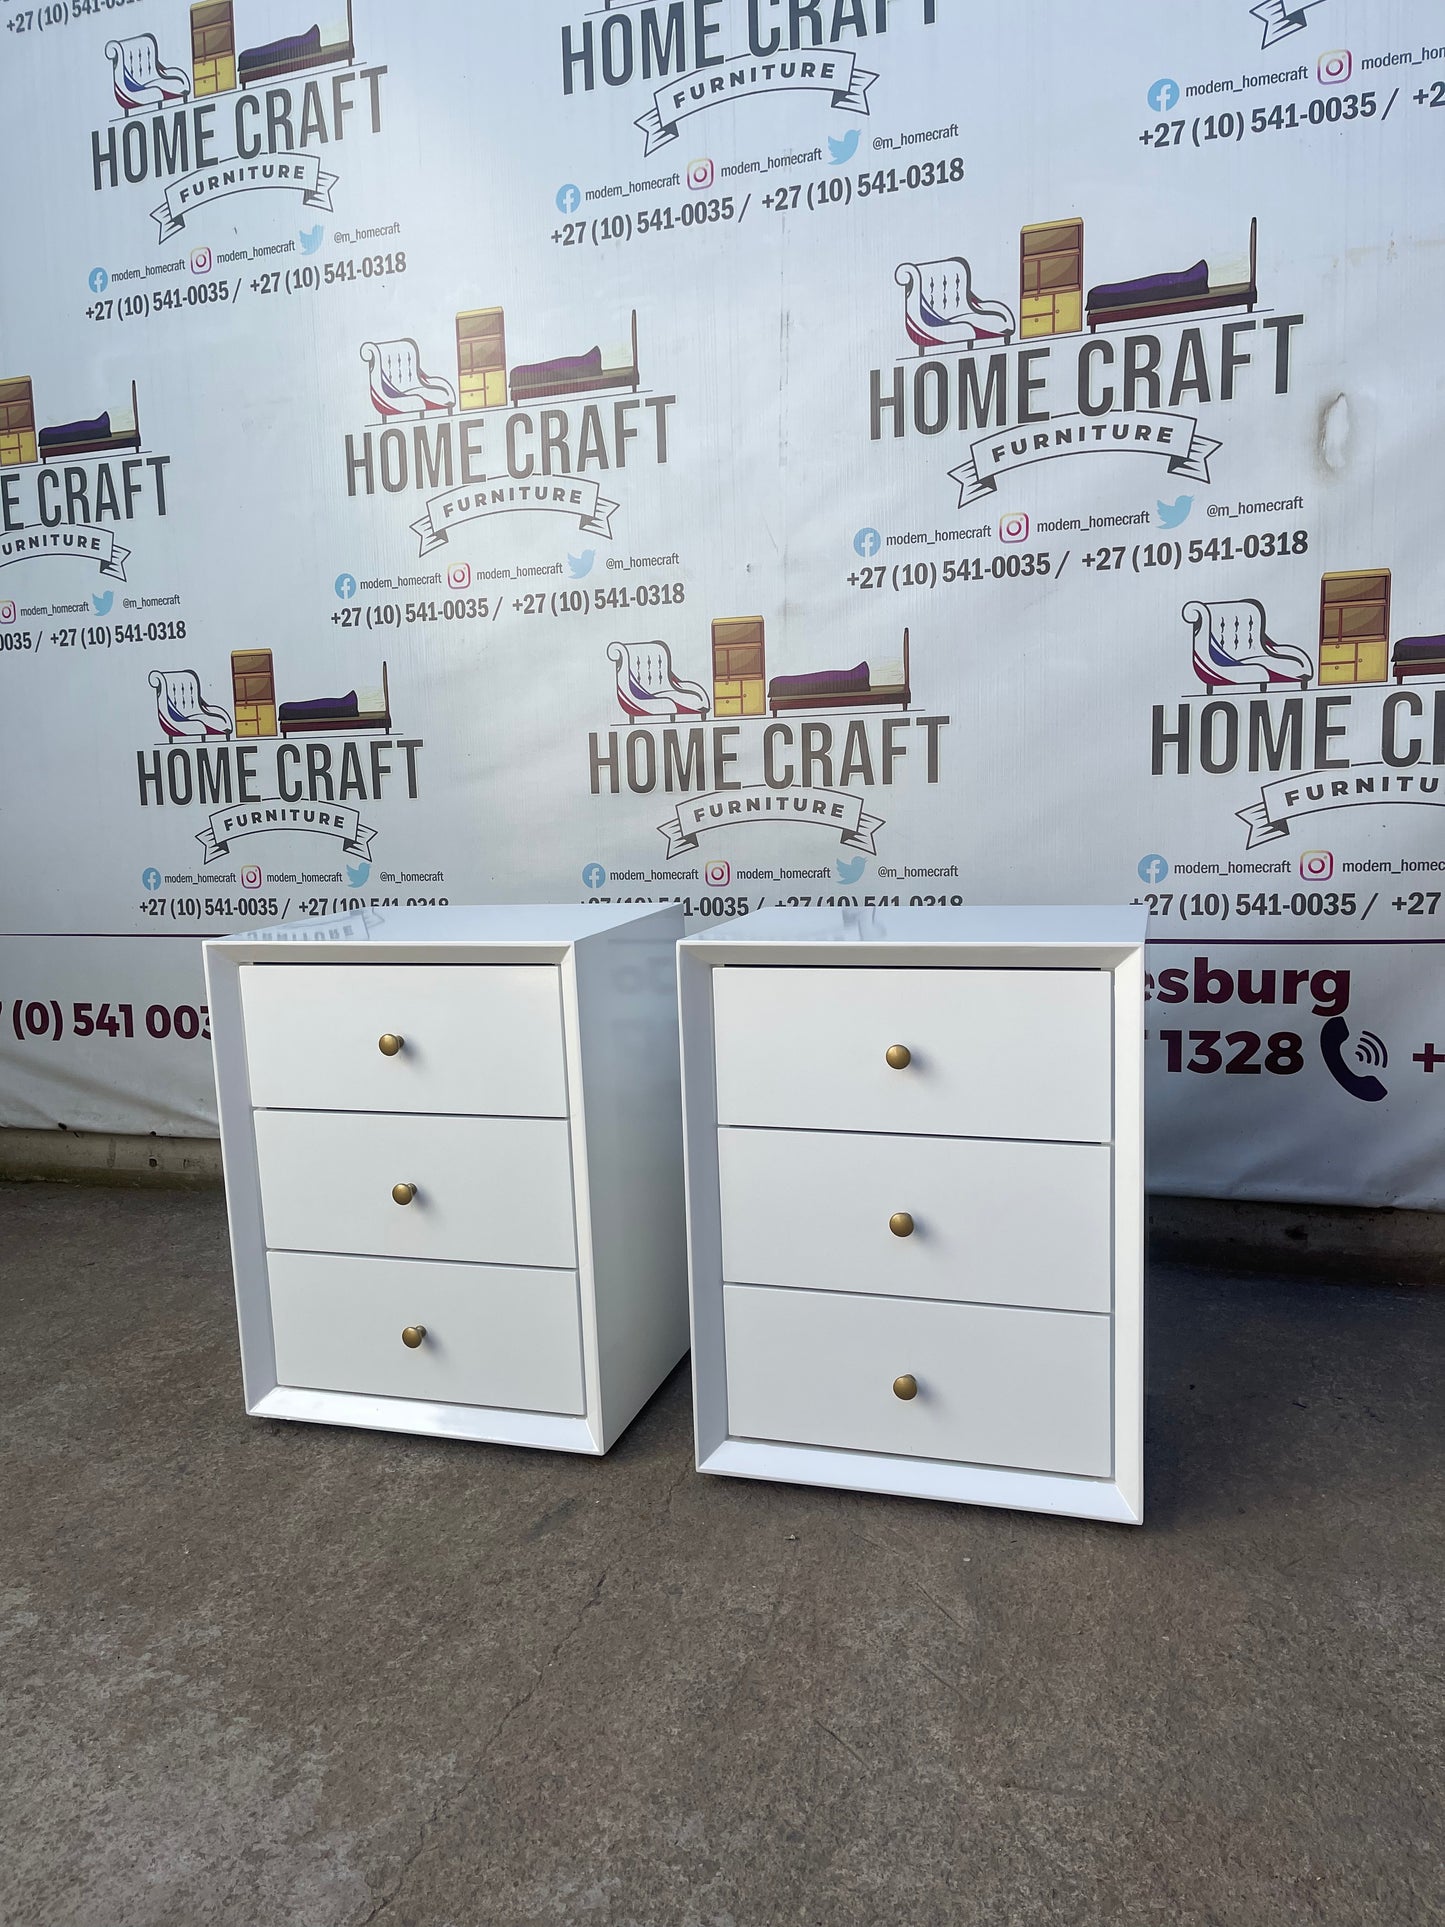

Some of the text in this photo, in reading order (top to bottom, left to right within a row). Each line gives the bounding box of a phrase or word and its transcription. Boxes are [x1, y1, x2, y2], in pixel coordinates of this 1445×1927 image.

[7, 11, 33, 33] +27
[38, 2, 68, 31] (10)
[562, 0, 725, 95] HOME
[674, 62, 836, 109] FURNITURE
[91, 65, 388, 191] HOME CRAFT
[872, 124, 958, 150] @m_homecraft
[1139, 119, 1186, 148] +27
[1192, 111, 1245, 147] (10)
[1251, 92, 1377, 134] 541-0035
[179, 164, 306, 203] FURNITURE
[551, 222, 587, 247] +27
[591, 214, 633, 246] (10)
[637, 196, 734, 234] 541-0035
[762, 186, 802, 212] +27
[807, 177, 852, 210] (10)
[857, 157, 965, 198] 541-0318
[334, 222, 401, 245] @m_homecraft
[85, 301, 113, 322] +27
[118, 294, 150, 320] (10)
[152, 281, 230, 312] 541-0035
[250, 271, 281, 296] +27
[285, 265, 320, 295] (10)
[324, 252, 407, 285] 541-0318
[869, 314, 1304, 440] HOME CRAFT
[344, 395, 676, 496] HOME CRAFT
[991, 425, 1174, 463] FURNITURE
[37, 456, 171, 528] CRAFT
[442, 486, 583, 518] FURNITURE
[1206, 495, 1304, 518] @m_homecraft
[2, 534, 100, 555] URNITURE
[606, 553, 680, 572] @m_homecraft
[847, 565, 887, 590] +27
[892, 561, 937, 592] (10)
[942, 552, 1051, 583] 541-0035
[1082, 547, 1126, 572] +27
[1132, 541, 1182, 573] (10)
[1188, 530, 1309, 563] 541-0318
[331, 608, 362, 628] +27
[366, 604, 401, 630] (10)
[405, 598, 489, 623] 541-0035
[512, 593, 546, 615] +27
[550, 590, 590, 616] (10)
[594, 583, 685, 610] 541-0318
[50, 629, 77, 648] +27
[81, 626, 112, 650] (10)
[115, 620, 187, 643] 541-0318
[588, 715, 950, 795] HOME CRAFT
[1151, 695, 1351, 776] HOME
[136, 739, 423, 806] HOME CRAFT
[224, 809, 345, 831] FURNITURE
[693, 797, 845, 823] FURNITURE
[380, 870, 444, 884] @m_homecraft
[877, 864, 959, 880] @m_homecraft
[140, 898, 166, 916] +27
[170, 898, 202, 920] (10)
[205, 898, 278, 916] 541-0035
[299, 898, 328, 916] +27
[1179, 893, 1229, 920] (10)
[1235, 893, 1356, 917] 541-0035
[1392, 891, 1441, 916] +27
[13, 999, 63, 1041] (0)
[73, 1003, 134, 1038] 541
[1160, 1029, 1304, 1075] 1328
